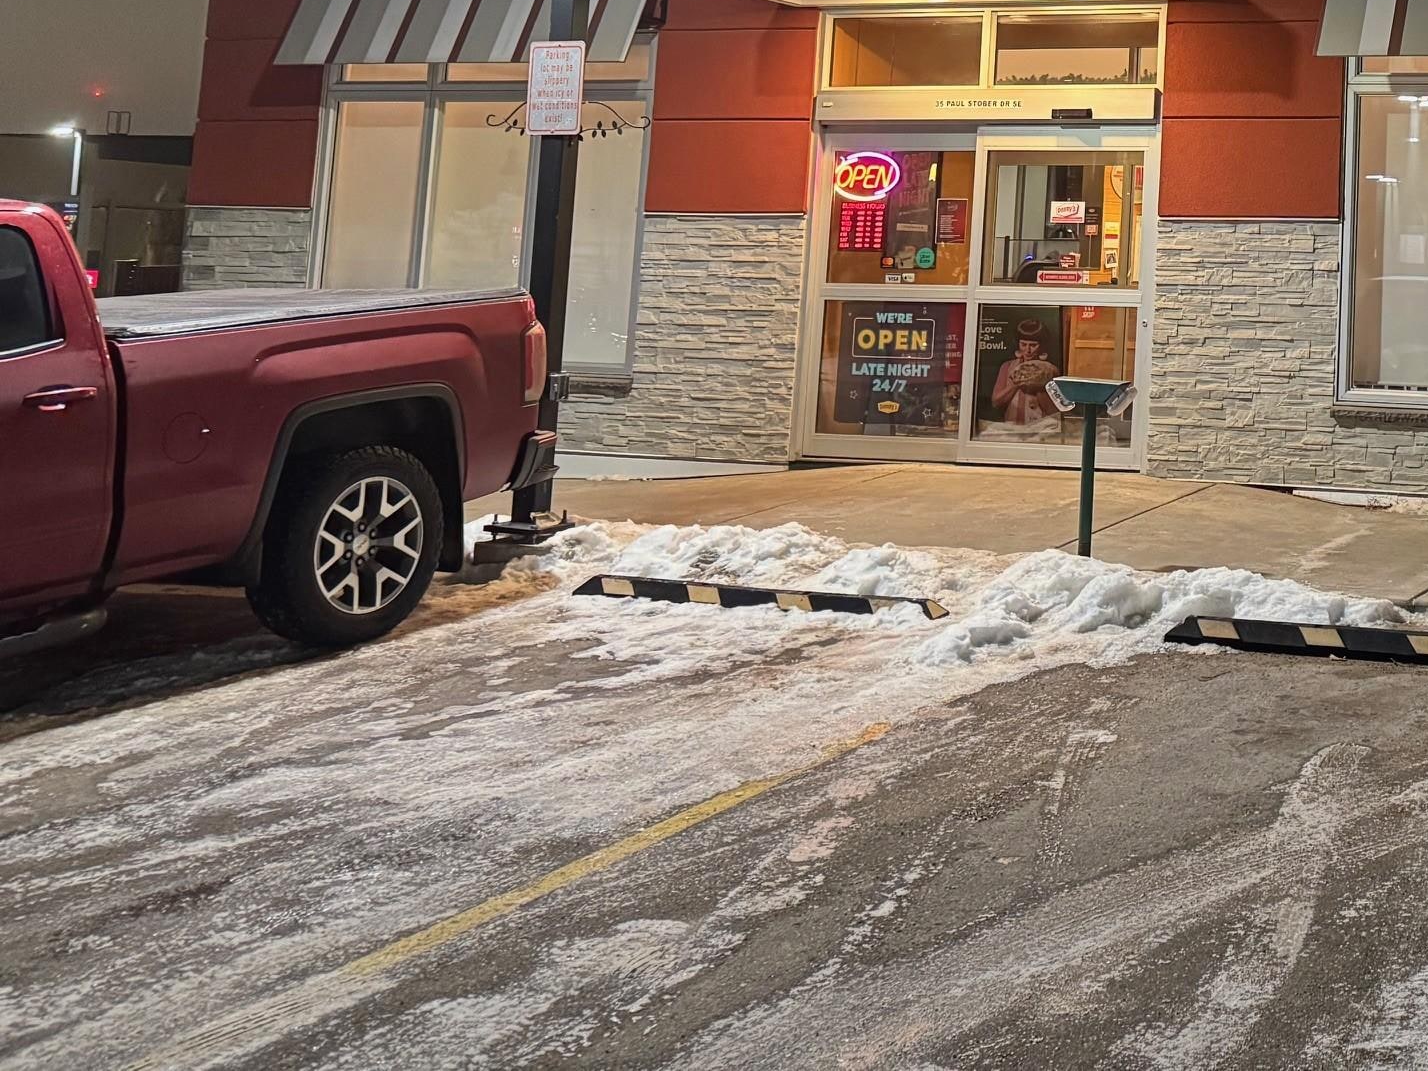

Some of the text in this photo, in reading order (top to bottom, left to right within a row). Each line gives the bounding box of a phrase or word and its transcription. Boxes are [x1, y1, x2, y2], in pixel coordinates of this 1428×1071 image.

[544, 50, 570, 61] Parking
[551, 65, 563, 73] may
[543, 76, 570, 86] slippery
[555, 89, 565, 99] icy
[544, 101, 578, 111] conditions
[837, 164, 894, 189] OPEN
[876, 312, 913, 324] WE'RE
[980, 325, 1002, 333] Love
[857, 329, 928, 351] OPEN
[979, 341, 1007, 350] Bowl.
[851, 362, 931, 377] LATE NIGHT
[872, 378, 907, 392] 24/7
